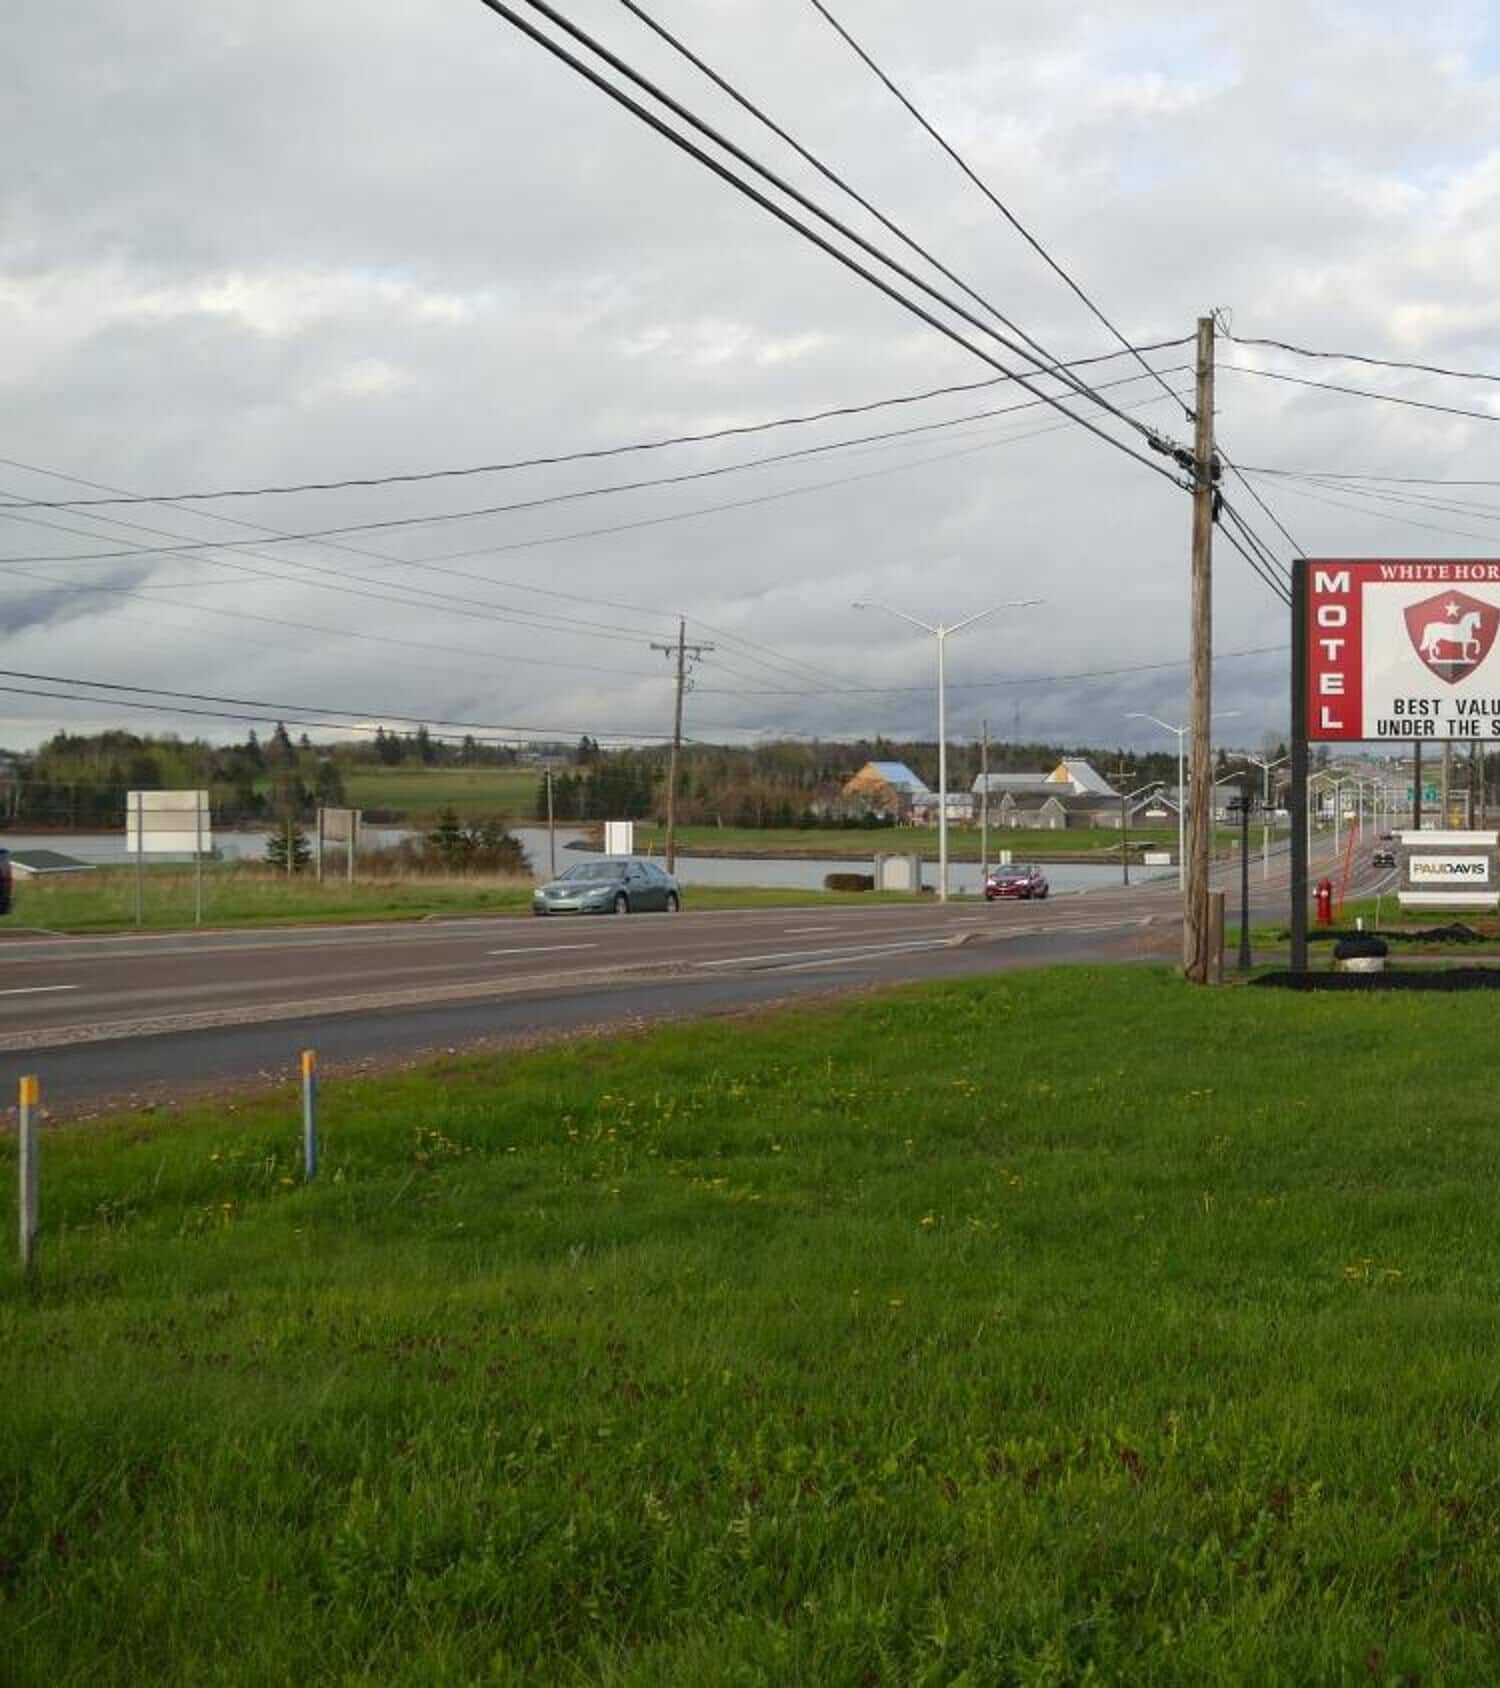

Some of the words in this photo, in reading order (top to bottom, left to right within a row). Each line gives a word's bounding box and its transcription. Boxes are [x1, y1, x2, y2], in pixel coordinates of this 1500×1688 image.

[1380, 564, 1449, 579] WHITE
[1315, 571, 1350, 729] MOTEL
[1393, 699, 1441, 715] BEST
[1377, 719, 1435, 736] UNDER
[1447, 719, 1480, 736] THE
